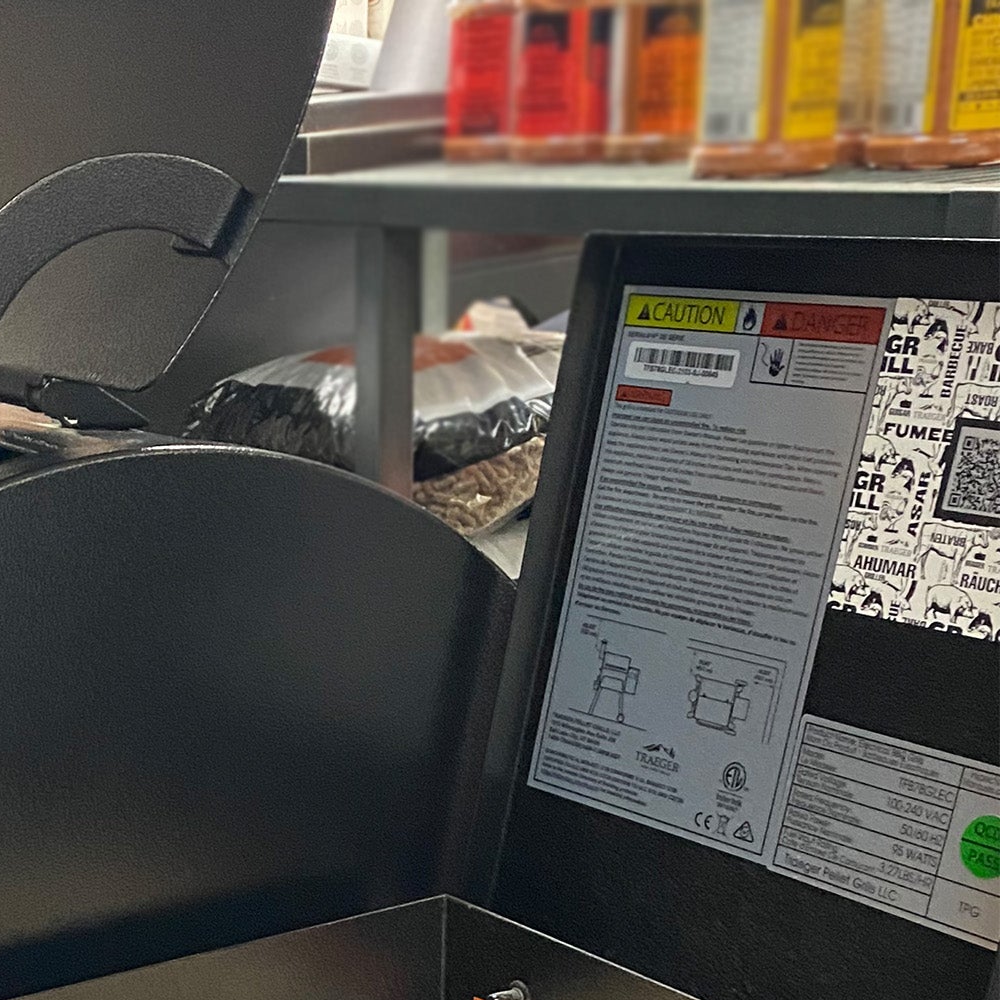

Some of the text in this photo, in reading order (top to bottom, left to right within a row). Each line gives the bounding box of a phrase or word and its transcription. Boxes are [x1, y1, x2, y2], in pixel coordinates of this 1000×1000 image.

[651, 302, 727, 325] CAUTION
[791, 310, 873, 335] DANGER
[885, 334, 920, 355] GR
[966, 341, 994, 355] BAKE
[940, 325, 967, 398] BARBECUE
[965, 393, 998, 407] ROAST
[853, 470, 886, 493] GR
[853, 554, 917, 579] AHUMAR
[635, 750, 680, 773] TRAEGER
[905, 847, 938, 868] WATTS
[784, 853, 822, 875] Traeger
[877, 885, 899, 901] LLC
